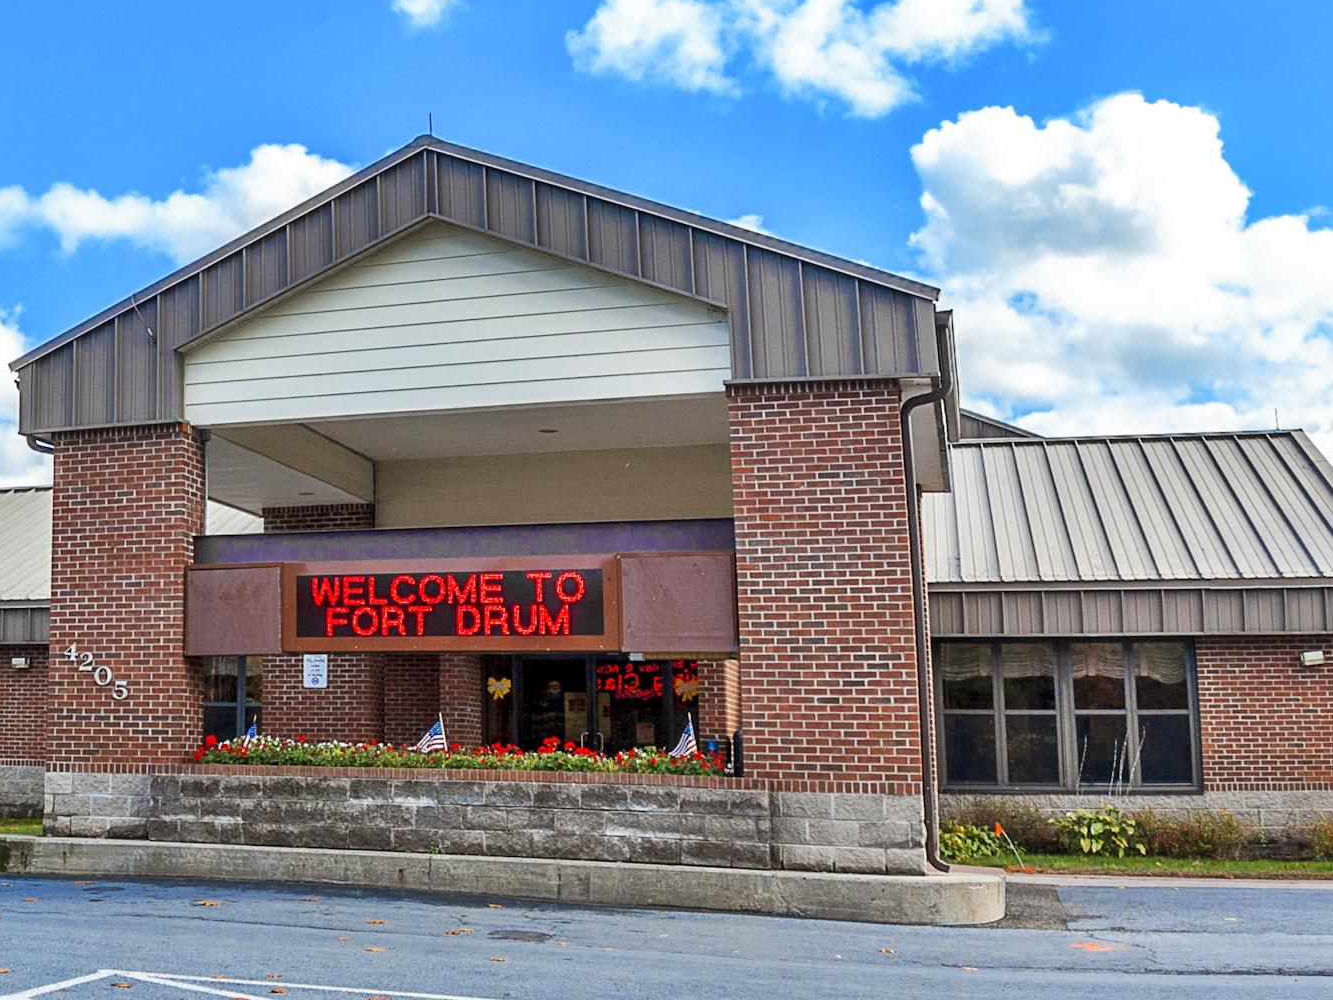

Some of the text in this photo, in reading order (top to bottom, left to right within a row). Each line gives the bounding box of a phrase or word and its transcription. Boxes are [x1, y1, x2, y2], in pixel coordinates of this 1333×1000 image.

[311, 572, 586, 606] WELCOME TO
[325, 603, 571, 636] FORT DRUM
[64, 642, 129, 700] 4205
